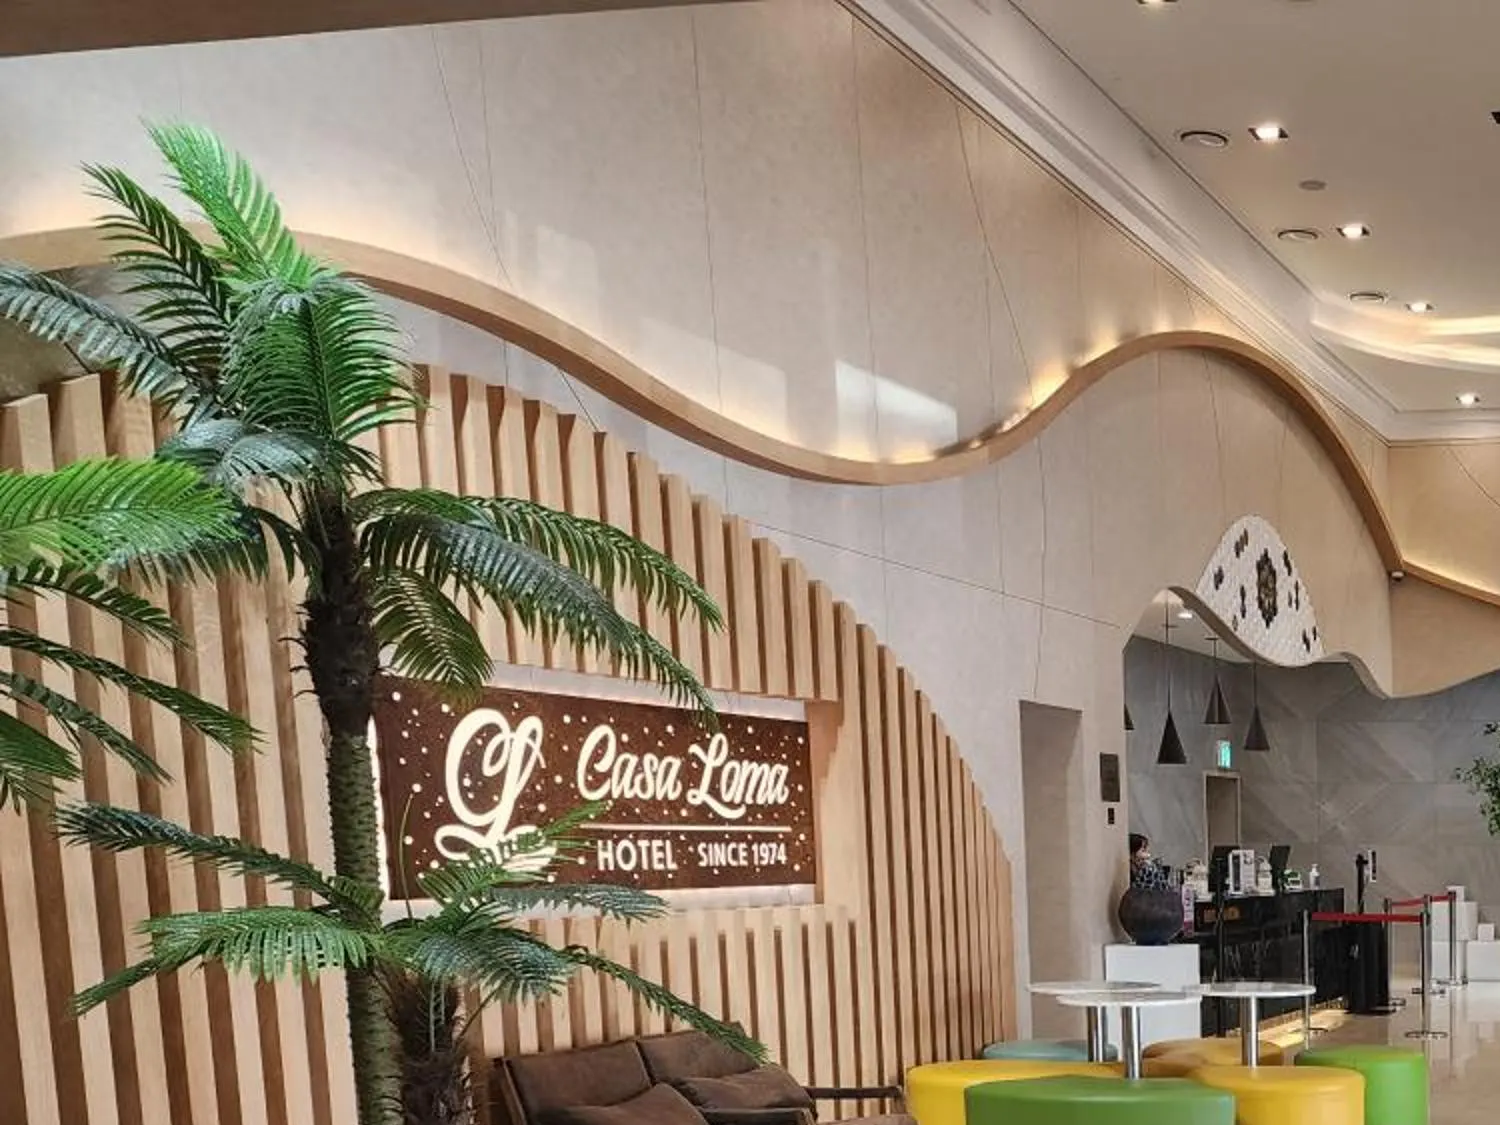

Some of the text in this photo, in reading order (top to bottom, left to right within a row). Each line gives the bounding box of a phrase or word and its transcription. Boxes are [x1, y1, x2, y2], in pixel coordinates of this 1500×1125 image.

[577, 724, 790, 820] Casa Loma
[597, 838, 787, 871] HOTEL SINCE 1974
